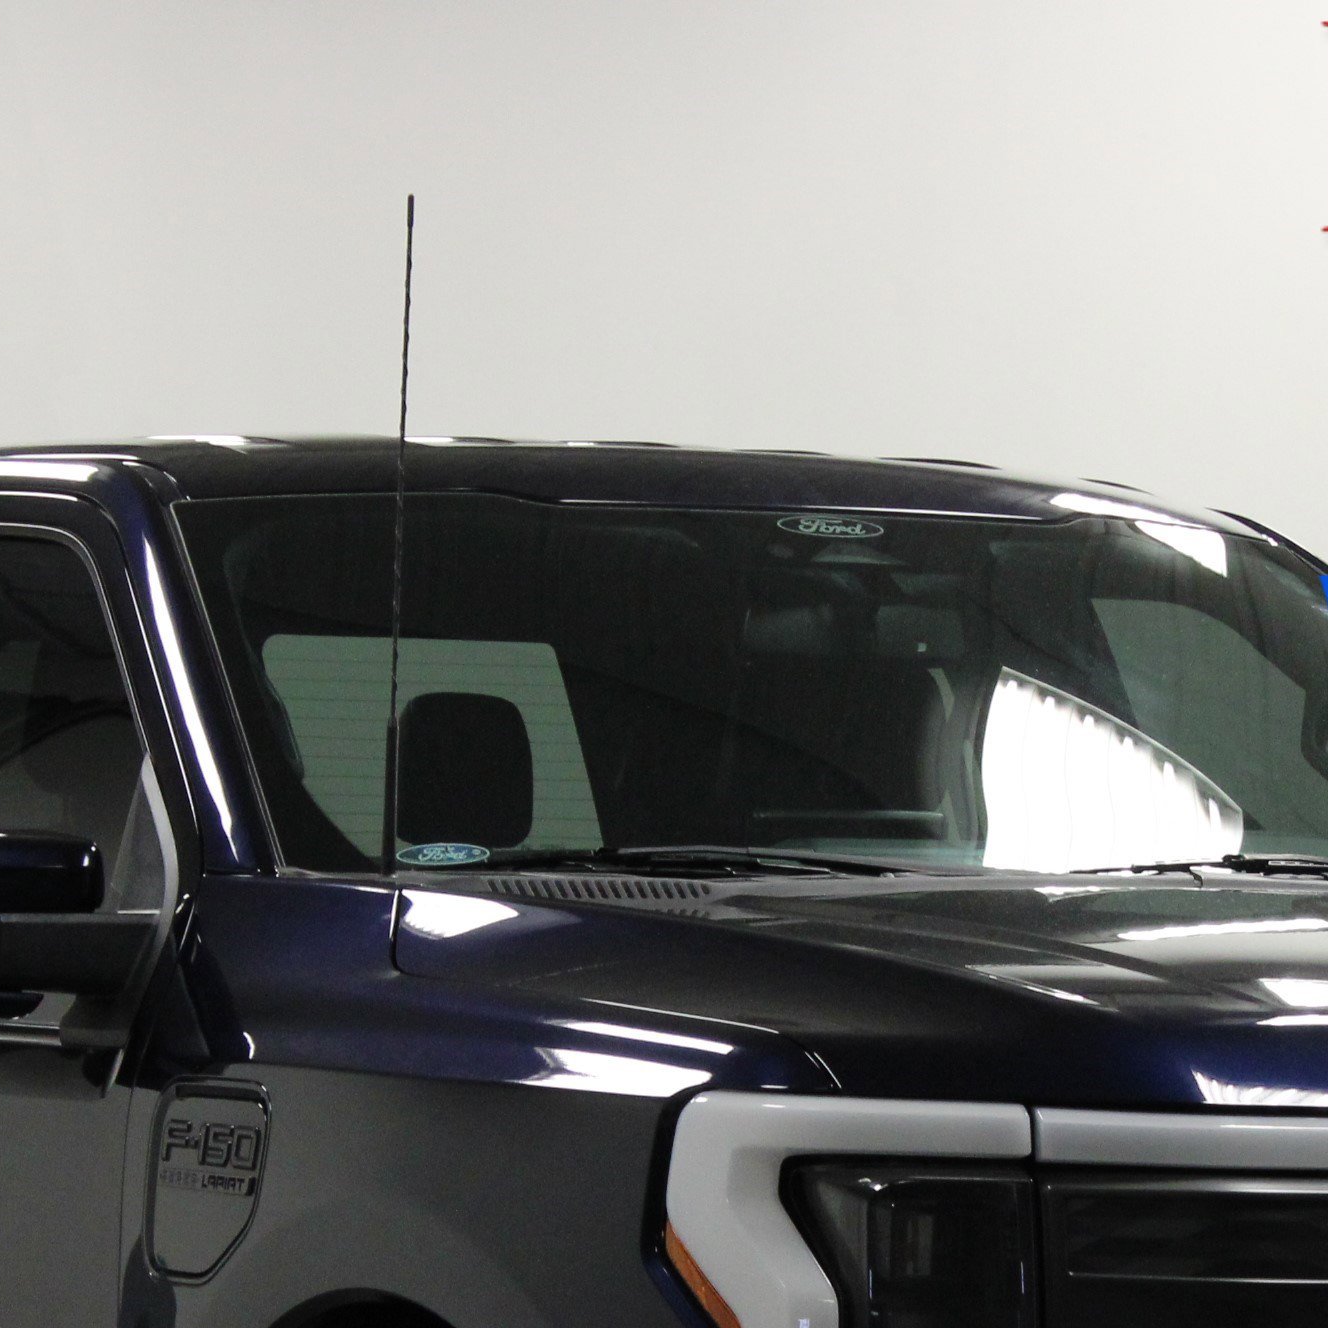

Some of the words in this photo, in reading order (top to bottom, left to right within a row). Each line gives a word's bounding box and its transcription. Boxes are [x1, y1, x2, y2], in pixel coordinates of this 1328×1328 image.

[798, 517, 866, 535] Ford
[161, 1118, 262, 1172] F-150
[200, 1173, 246, 1192] LARIAT
